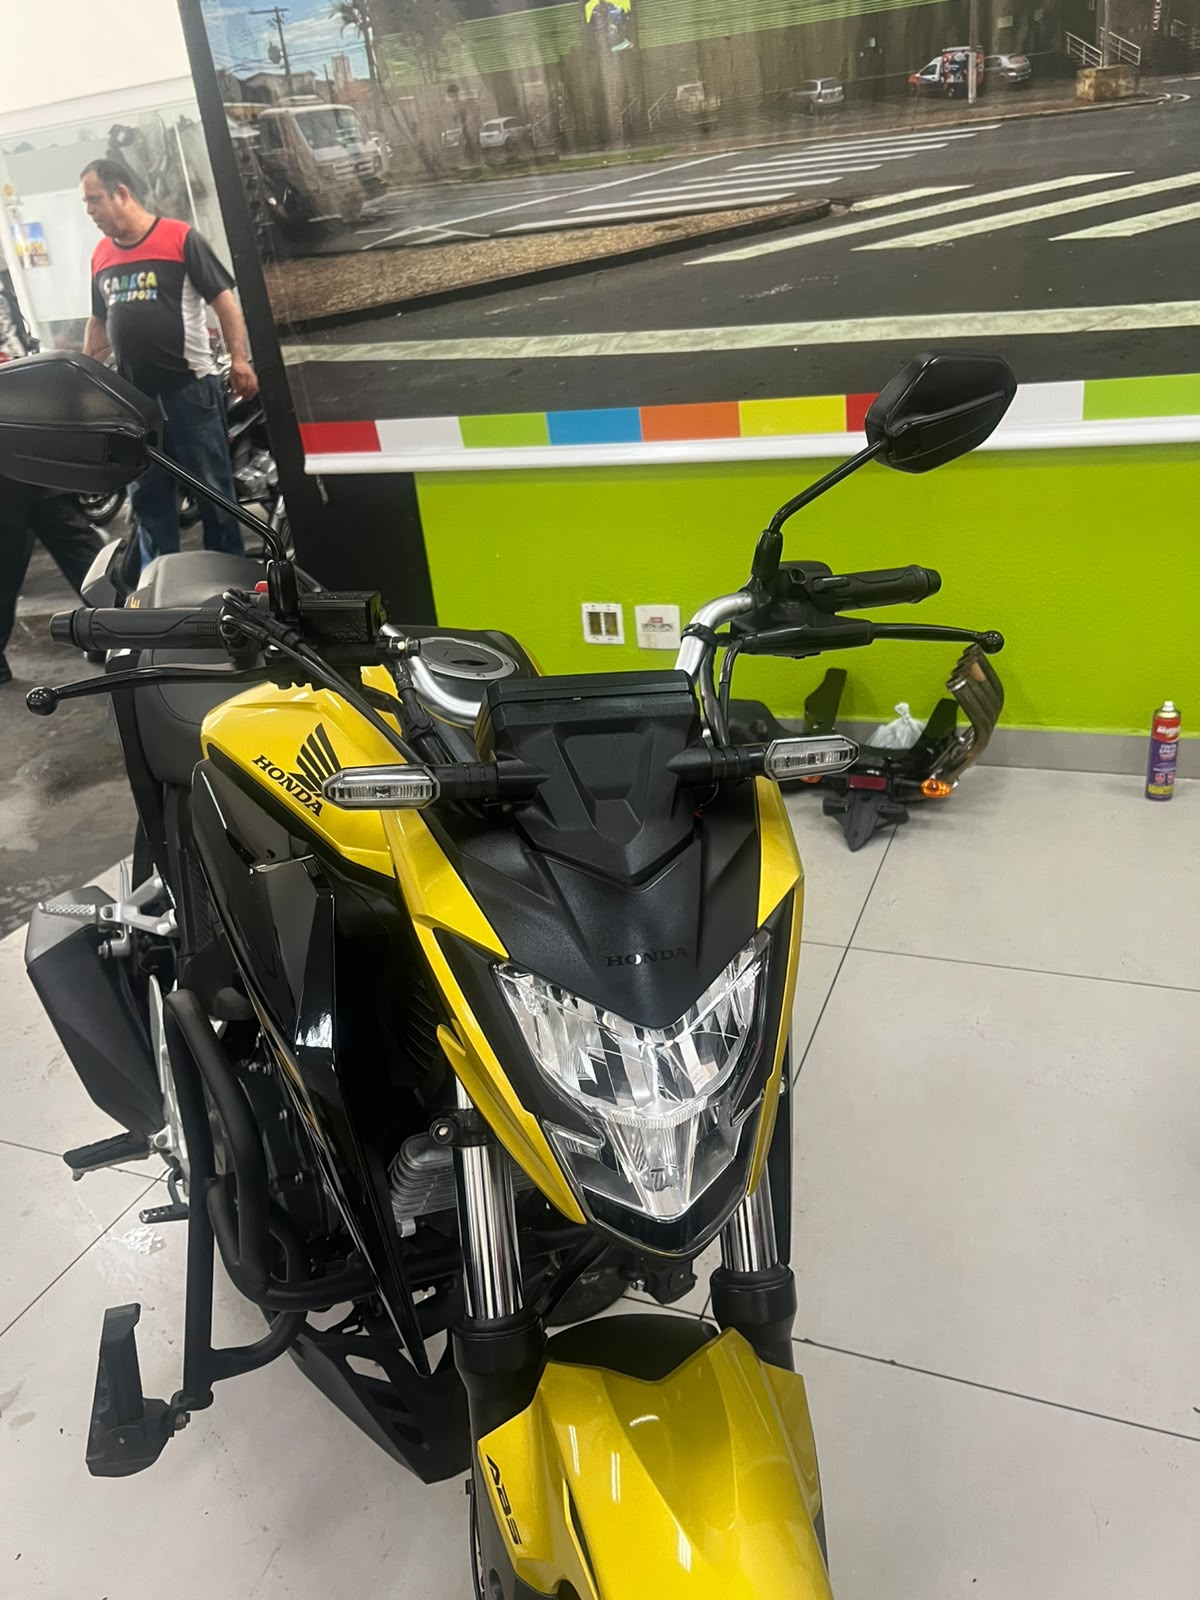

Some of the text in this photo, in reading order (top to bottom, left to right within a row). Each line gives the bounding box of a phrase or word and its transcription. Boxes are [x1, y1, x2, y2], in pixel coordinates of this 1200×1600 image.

[252, 754, 323, 817] HONDA
[606, 947, 689, 967] HONDA
[486, 1453, 523, 1546] ABS
